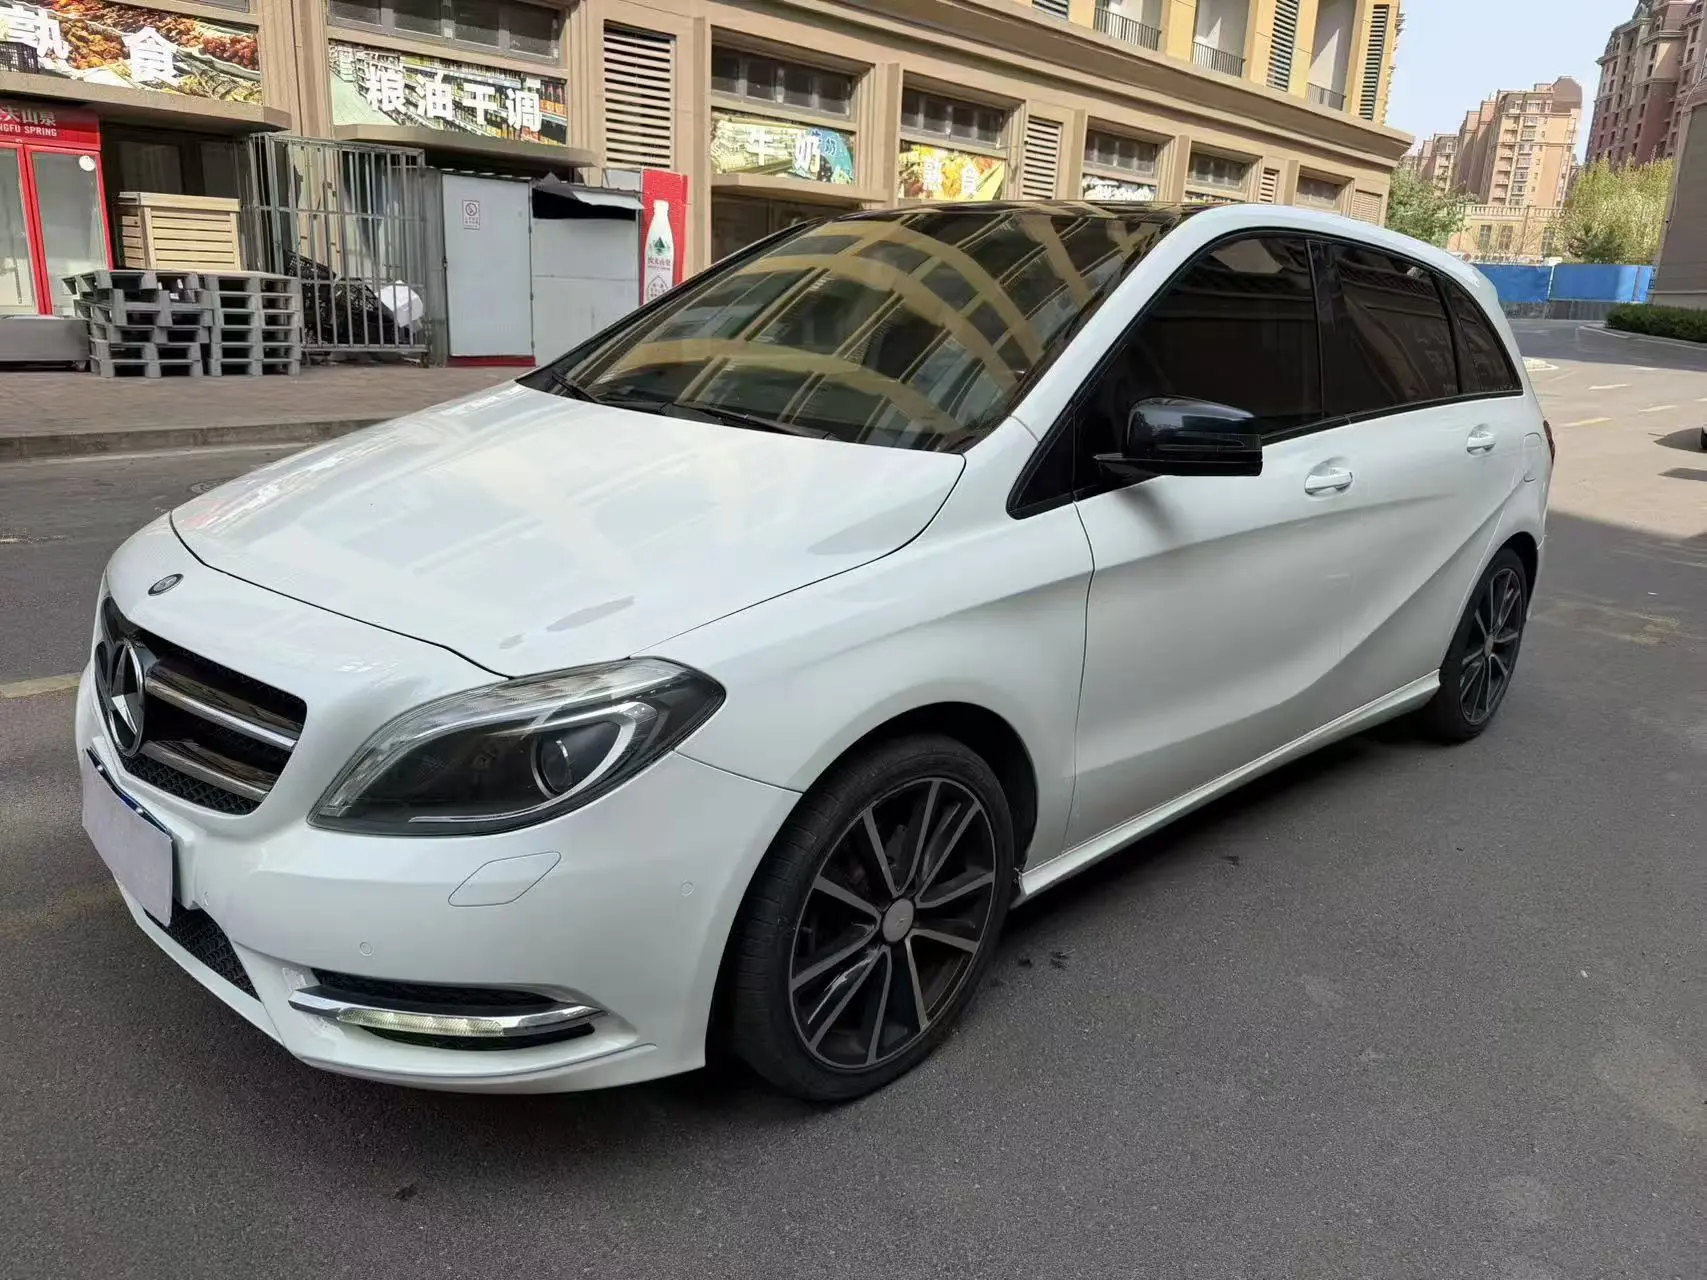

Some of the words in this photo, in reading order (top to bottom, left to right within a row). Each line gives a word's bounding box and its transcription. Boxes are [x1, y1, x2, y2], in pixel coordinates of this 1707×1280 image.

[366, 62, 543, 132] 粮油干调
[24, 126, 57, 137] SPRING
[745, 127, 821, 174] 牛奶
